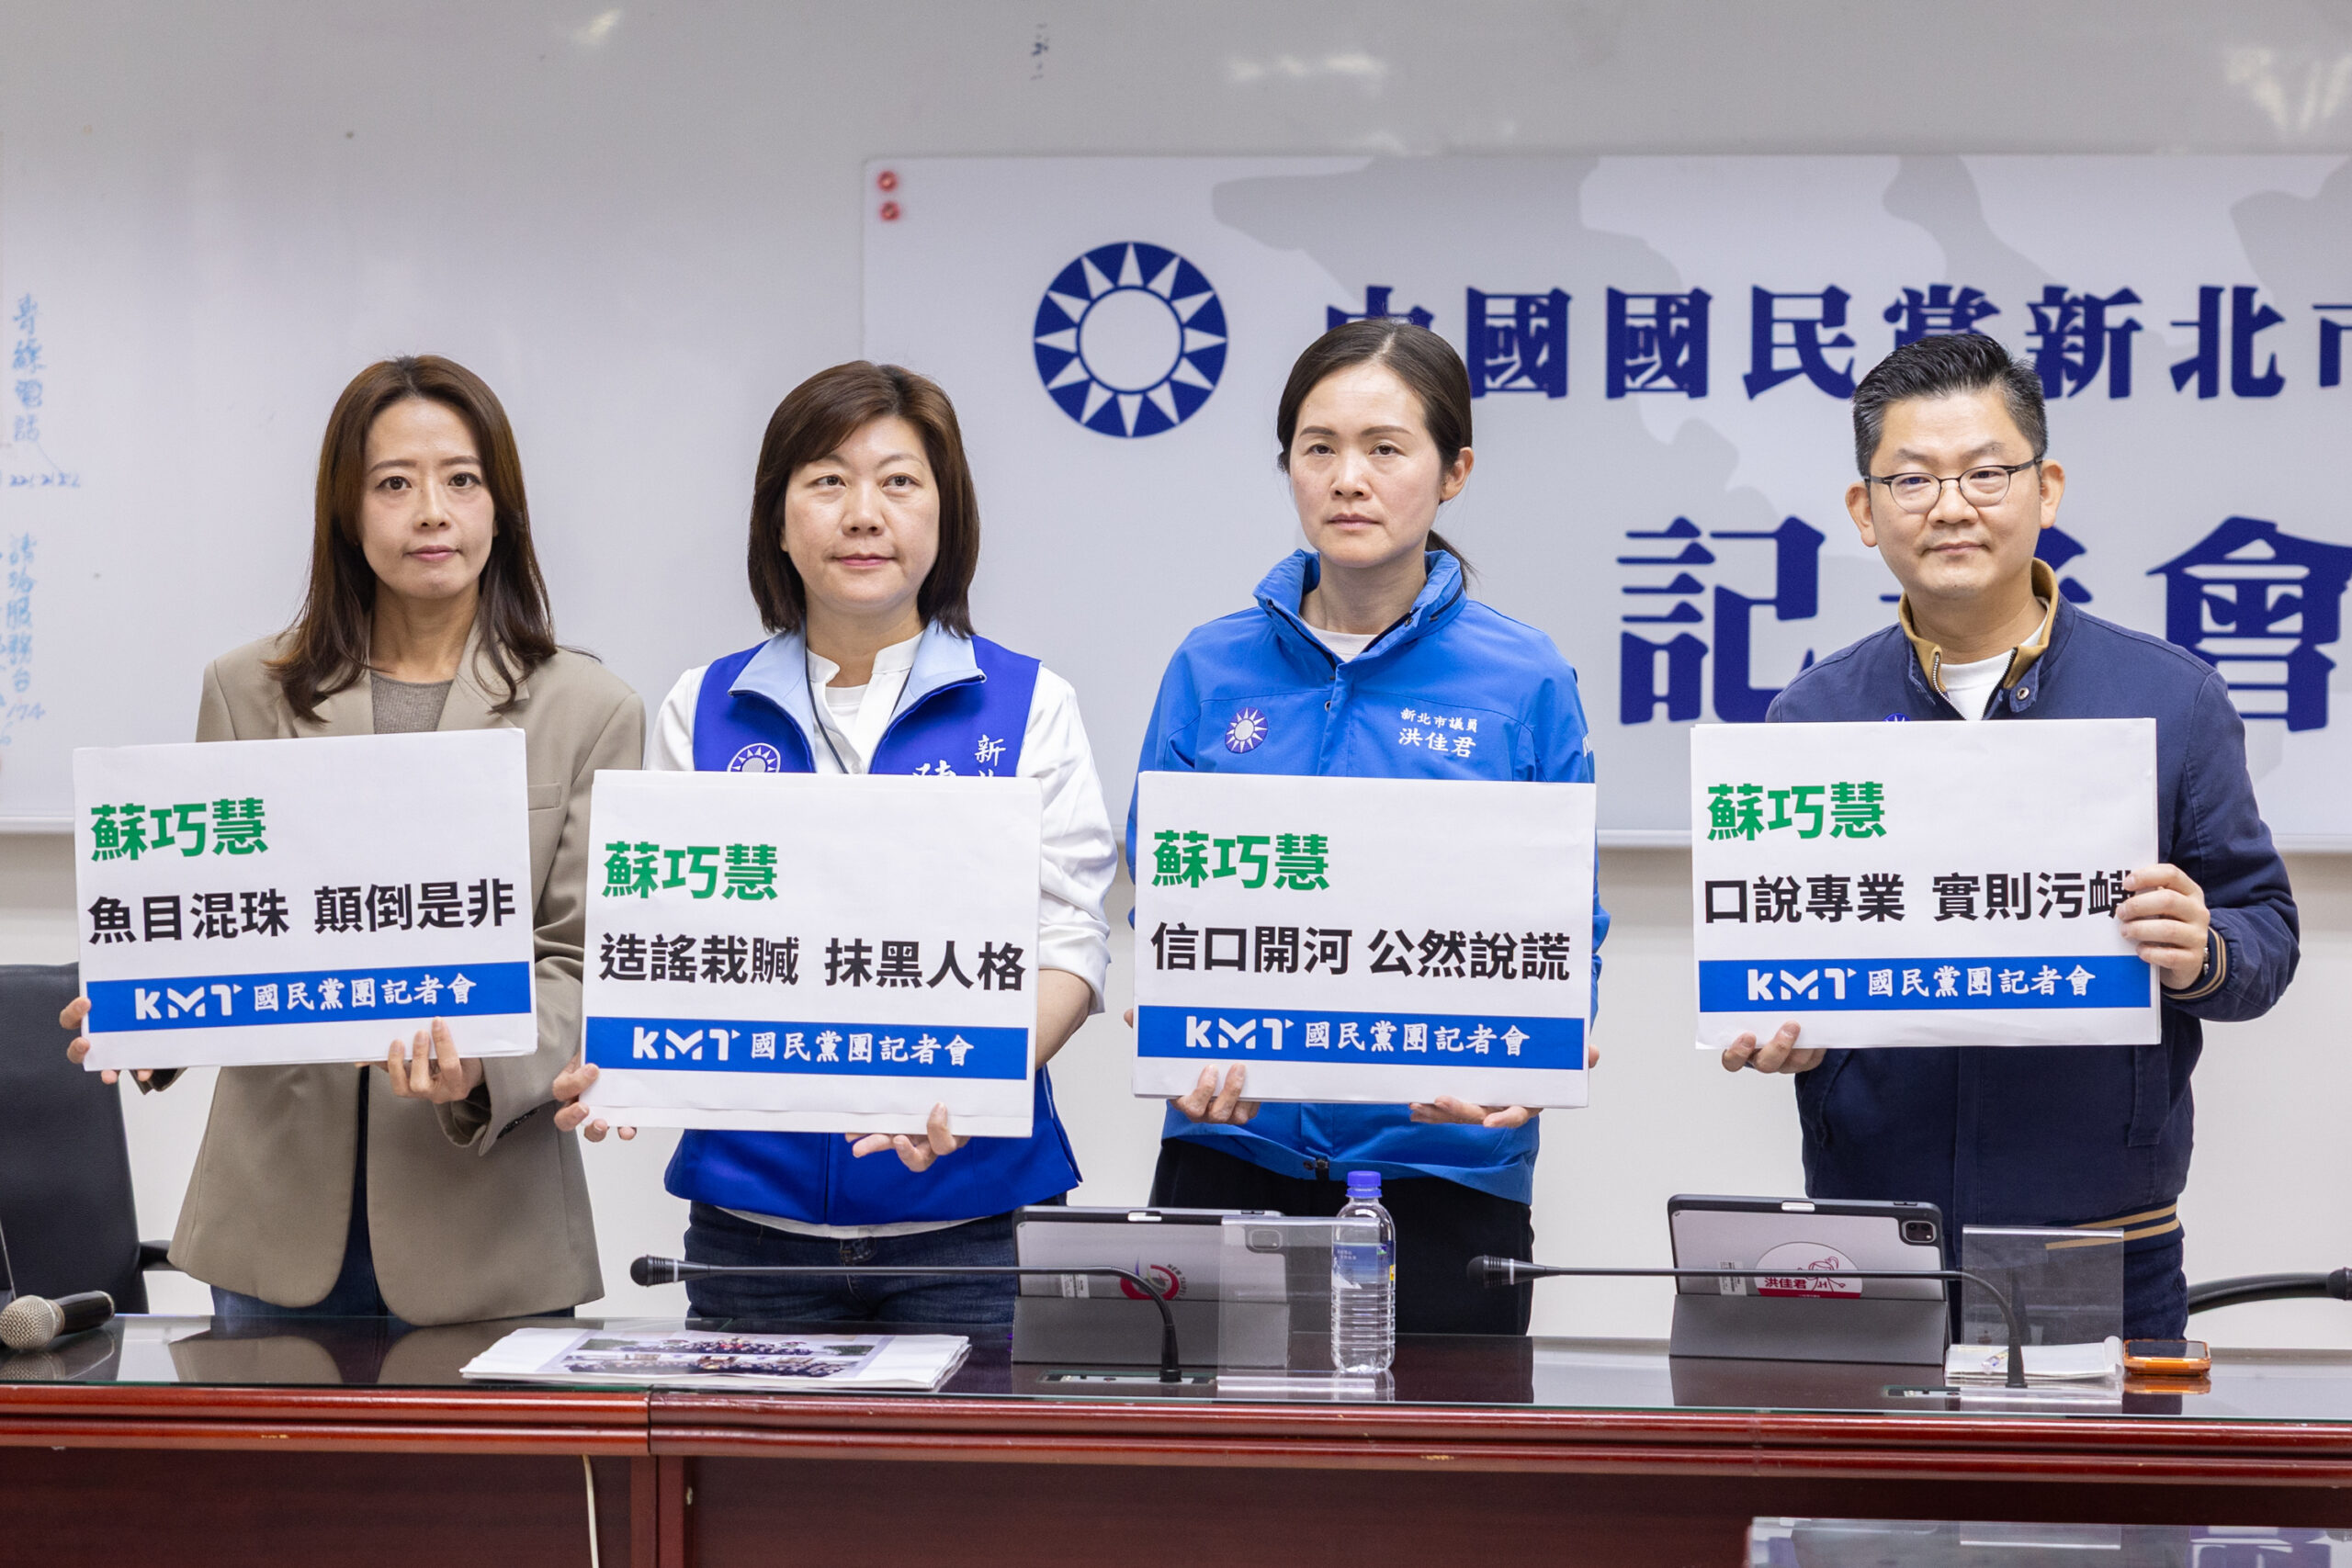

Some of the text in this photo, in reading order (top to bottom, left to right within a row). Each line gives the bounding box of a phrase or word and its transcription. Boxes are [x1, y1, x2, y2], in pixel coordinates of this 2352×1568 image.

[1617, 516, 2352, 733] 記會
[1398, 728, 1476, 758] 洪佳君
[1400, 707, 1478, 733] 新北市議員
[975, 734, 1007, 777] 新
[91, 797, 268, 862] 蘇巧慧
[1707, 781, 1887, 841] 蘇巧慧
[602, 840, 778, 901] 蘇巧慧
[1150, 829, 1330, 891] 蘇巧慧
[88, 878, 515, 945] 魚目混珠 顛倒是非
[1704, 873, 1905, 924] 口說專業
[599, 932, 1026, 991] 造謠栽贓 抹黑人格
[1150, 921, 1570, 981] 信口開河 公然說謊
[134, 972, 477, 1020] KMT 國民黨團記者會
[1747, 964, 2096, 1001] KMT 國民黨團記者會
[632, 1026, 975, 1066] KMT 國民黨團記者會
[1185, 1015, 1531, 1056] KMT 國民黨團記者會
[1764, 1277, 1807, 1290] 洪佳君
